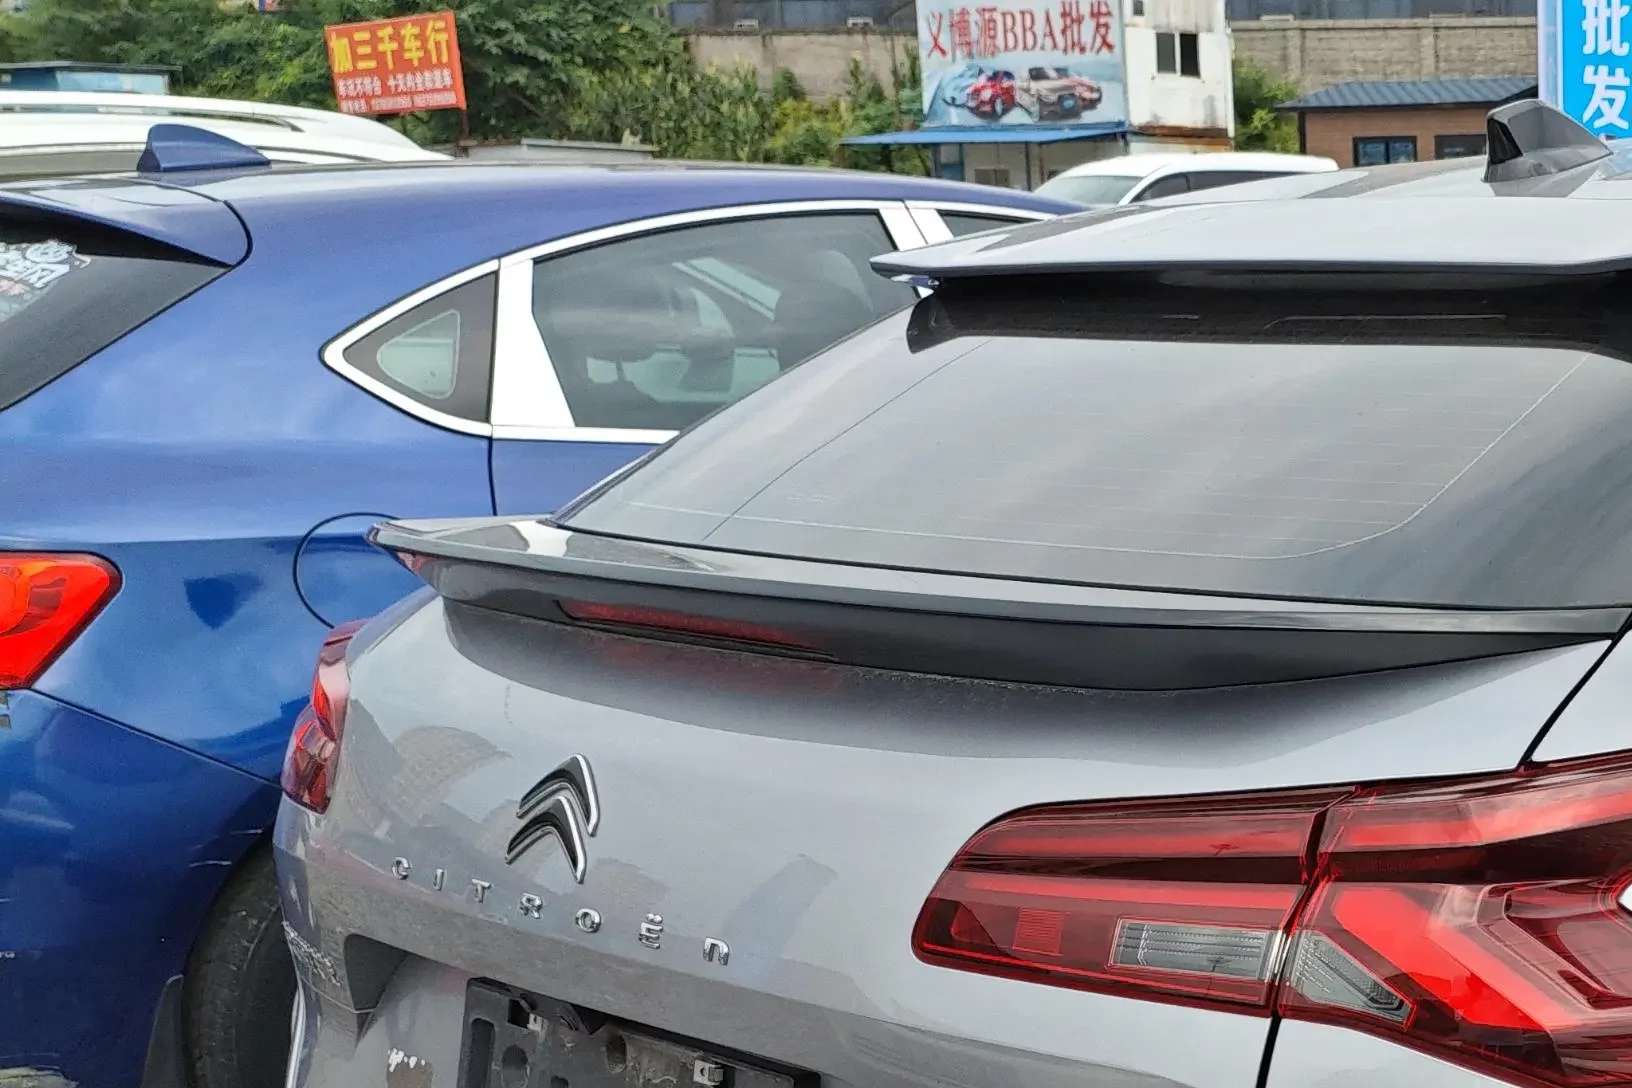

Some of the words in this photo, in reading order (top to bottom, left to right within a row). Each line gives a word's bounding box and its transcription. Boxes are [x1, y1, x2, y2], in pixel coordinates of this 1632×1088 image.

[329, 19, 449, 74] 加三千车行
